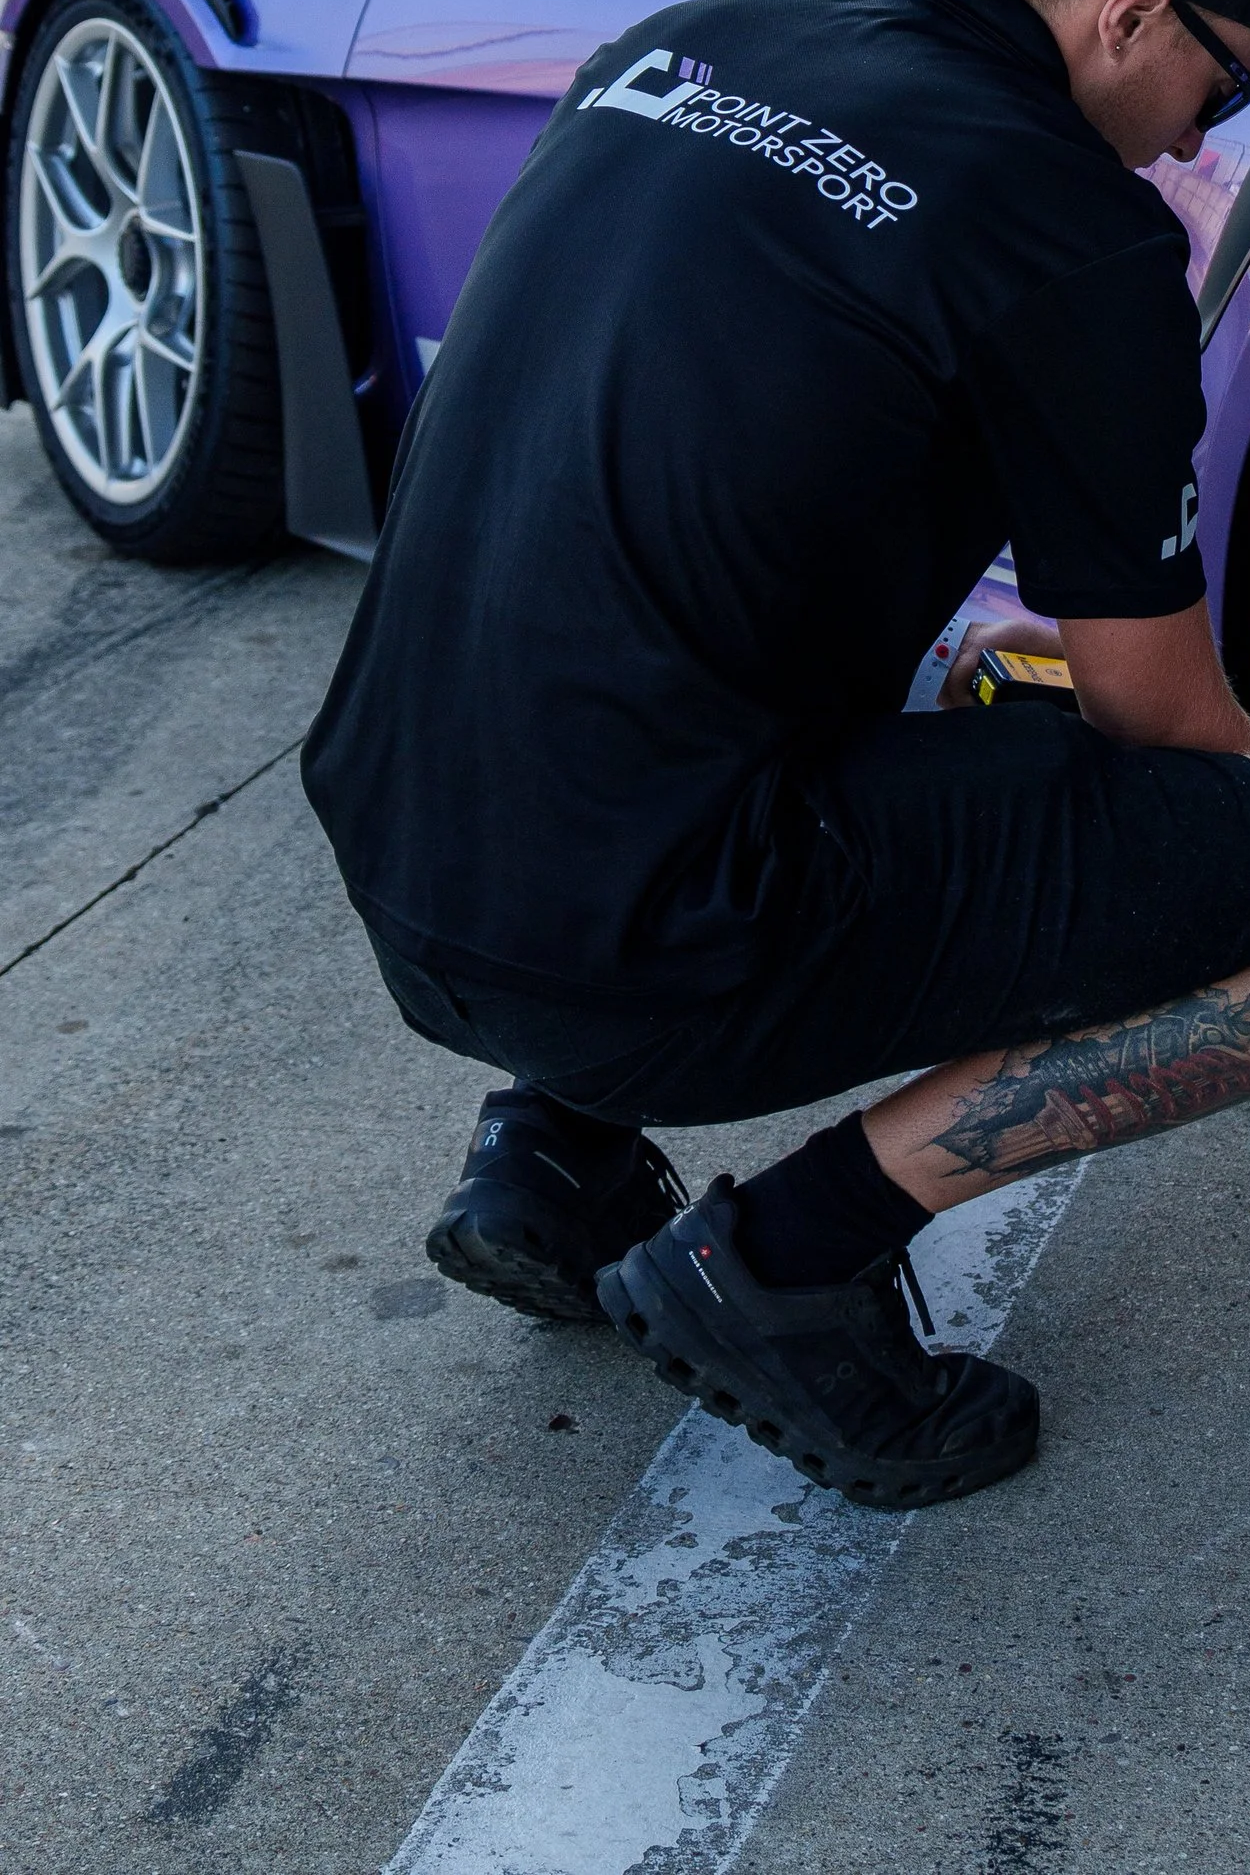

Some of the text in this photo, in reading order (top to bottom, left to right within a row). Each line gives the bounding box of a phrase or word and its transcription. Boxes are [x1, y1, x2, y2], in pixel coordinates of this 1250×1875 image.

[661, 106, 899, 230] MOTORSPORT
[687, 88, 919, 211] POINT ZERO
